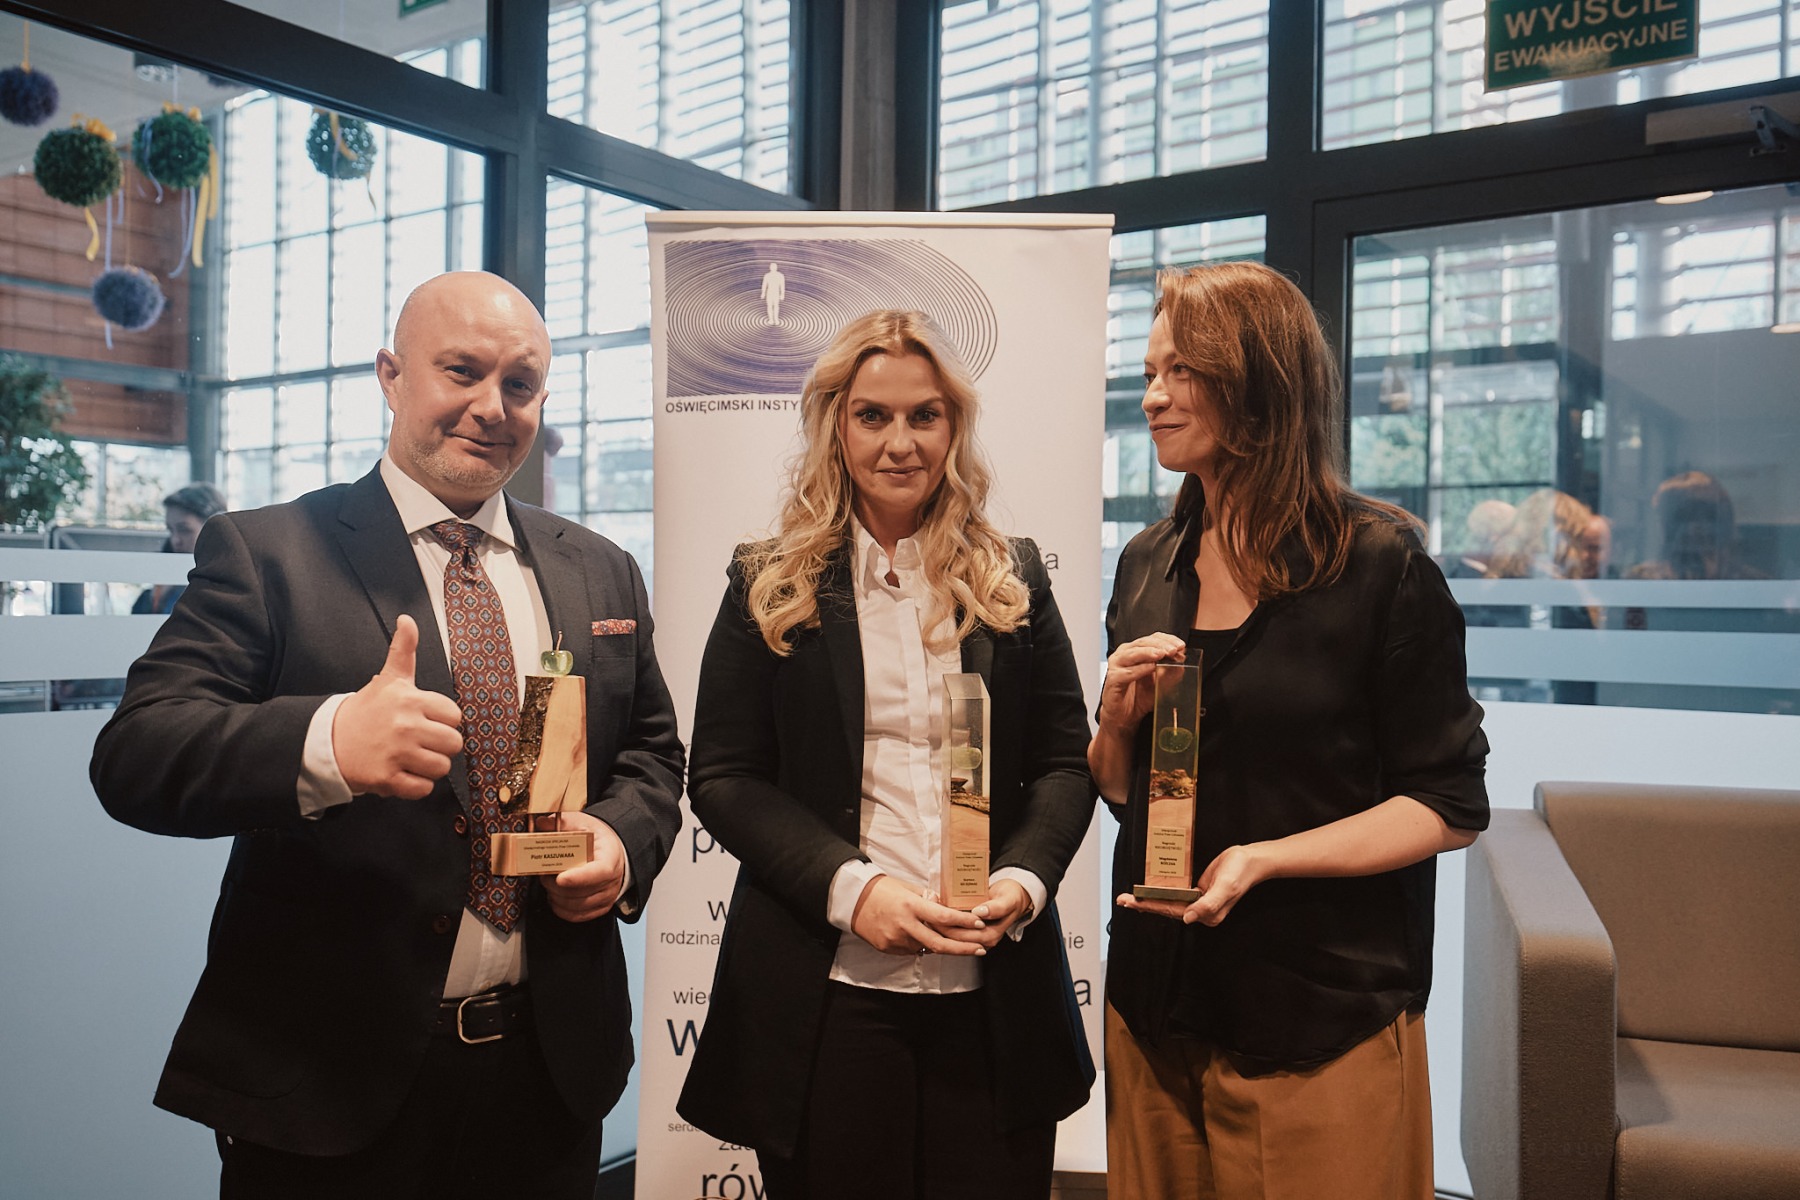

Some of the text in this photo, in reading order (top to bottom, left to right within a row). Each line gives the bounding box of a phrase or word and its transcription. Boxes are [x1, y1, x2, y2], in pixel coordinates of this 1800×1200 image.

[1494, 18, 1687, 72] EWAKUACYJNE
[665, 400, 754, 414] OŚWIĘCIMSKI
[660, 930, 721, 946] rodzina
[673, 987, 712, 1005] wie
